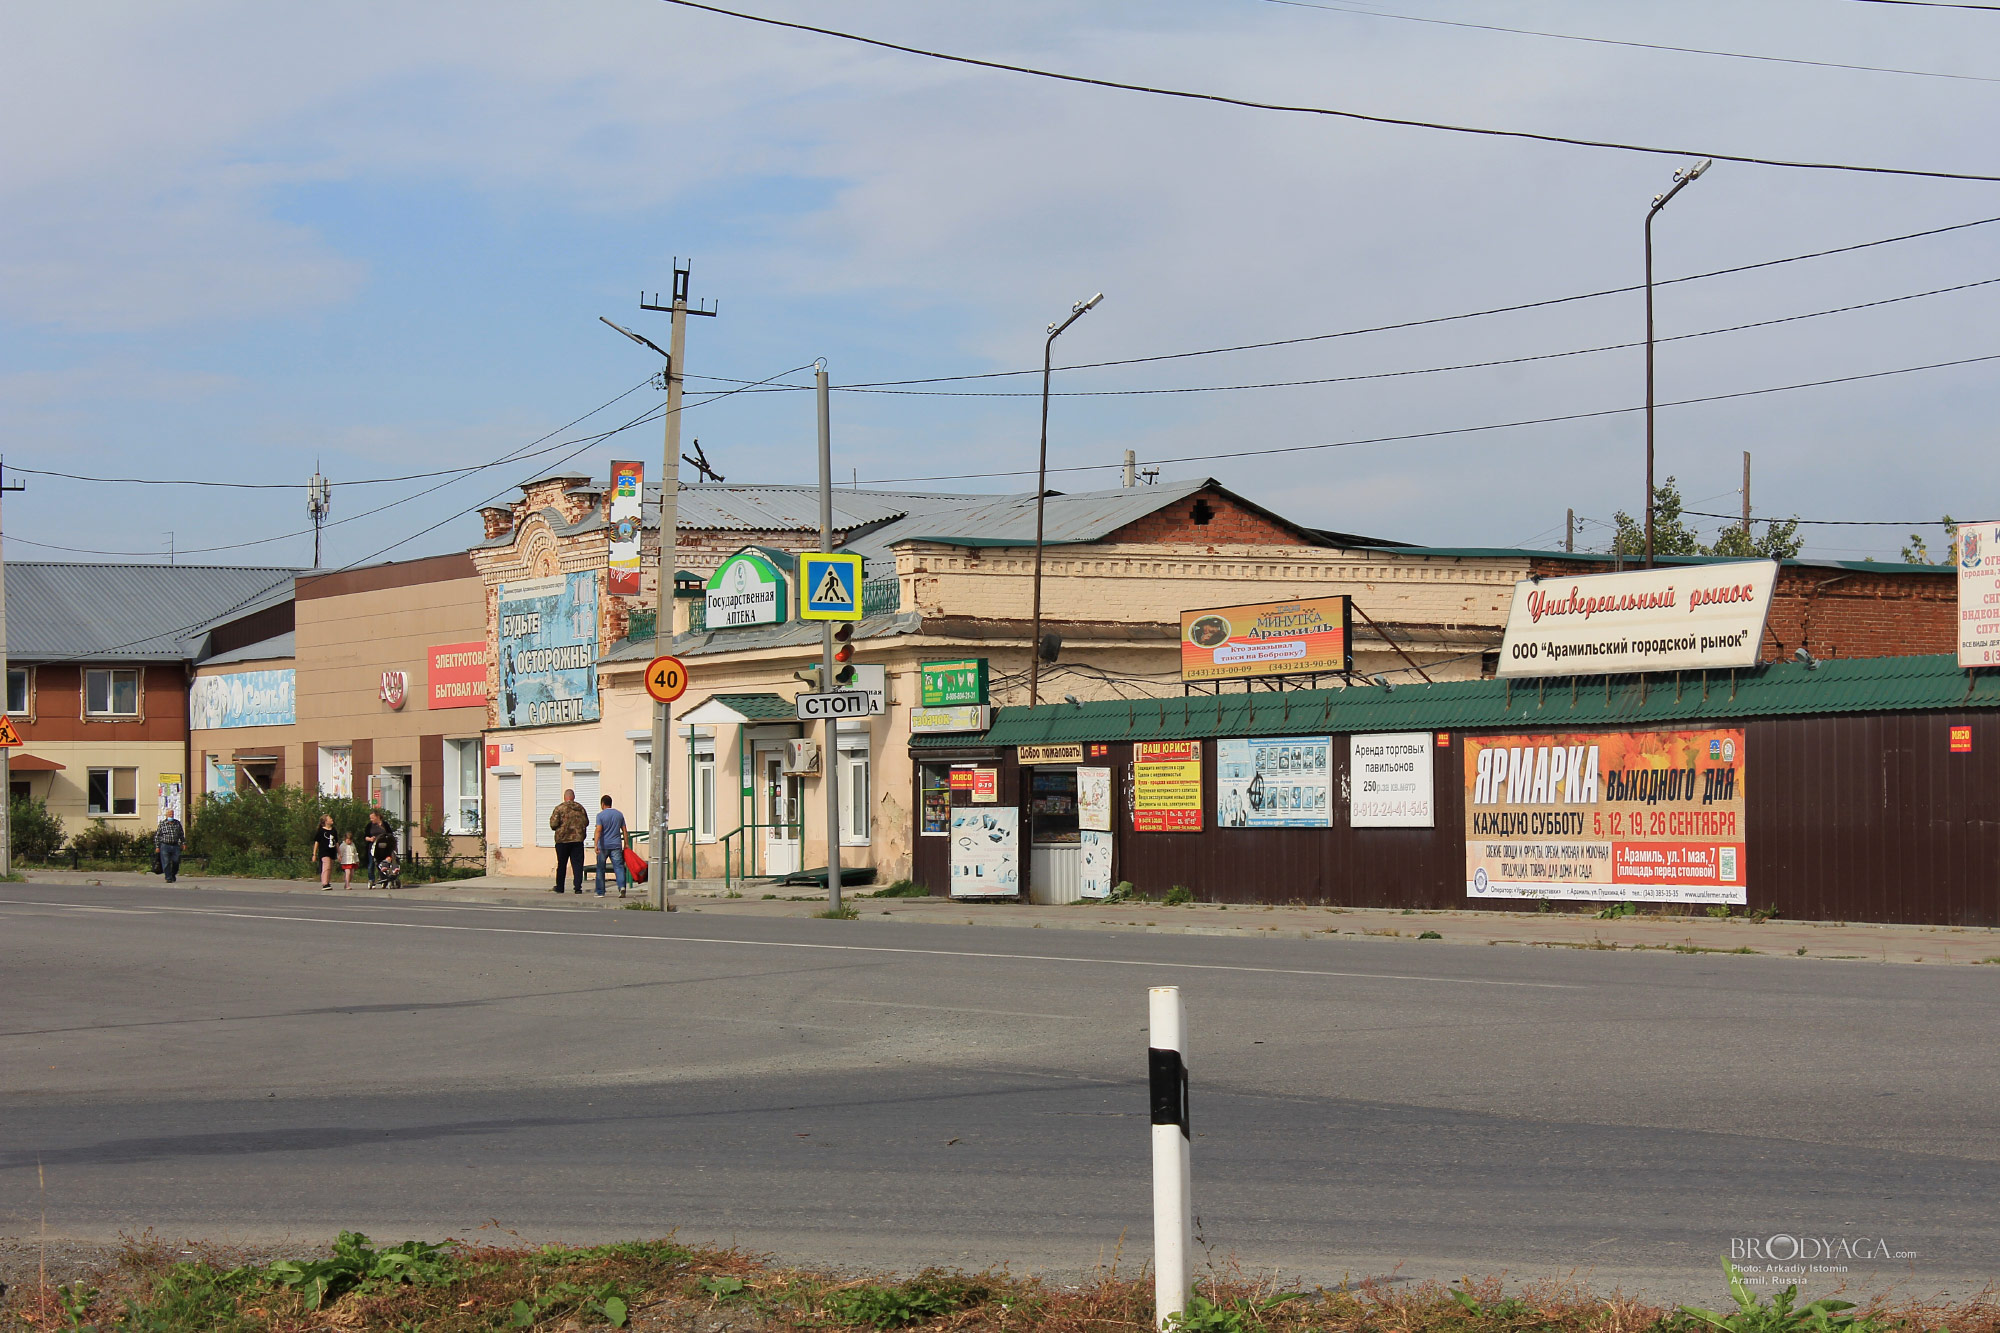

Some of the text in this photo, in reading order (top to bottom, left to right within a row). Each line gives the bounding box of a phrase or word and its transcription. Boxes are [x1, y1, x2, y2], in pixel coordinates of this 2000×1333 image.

[708, 590, 774, 610] Государственная
[1527, 583, 1754, 624] Универсальный рынок
[503, 612, 540, 640] БУДЬТЕ
[726, 610, 756, 625] АПТЕКА
[1257, 612, 1322, 628] МИНУТКА
[1248, 623, 1334, 640] Арамиль
[1230, 645, 1246, 653] Кто
[1512, 642, 1538, 660] ООО
[1632, 633, 1696, 656] городской
[517, 644, 592, 674] ОСТОРОЖНЫ
[1984, 650, 1990, 662] 8
[1187, 660, 1338, 678] (343) 213-00-09 (343) 213-90-09
[654, 670, 678, 688] 40
[435, 682, 470, 698] БЫТОВАЯ
[528, 697, 584, 724] С ОГНЕМ!
[805, 696, 861, 714] СТОП
[1952, 730, 1969, 740] МЯСО
[1020, 746, 1040, 759] Добро
[1042, 745, 1082, 758] пожаловать!
[1143, 742, 1190, 754] ВАШ ЮРИСТ
[1355, 744, 1424, 758] Аренда торговых
[1365, 762, 1414, 773] павильонов
[1474, 745, 1599, 804] ЯРМАРКА
[1606, 768, 1736, 805] ВЫХОДНОГО ДНЯ
[1353, 800, 1428, 817] 8-912-24-41-545
[1473, 811, 1736, 839] КАЖДУЮ СУББОТУ 5, 12, 19, 26 СЕНТЯБРЯ
[1624, 847, 1665, 867] Арамиль,
[1666, 850, 1680, 865] ул.
[1682, 848, 1686, 862] 1
[1688, 852, 1708, 864] мая,
[1710, 848, 1716, 863] 7
[1617, 863, 1716, 879] (площадь перед столовой)
